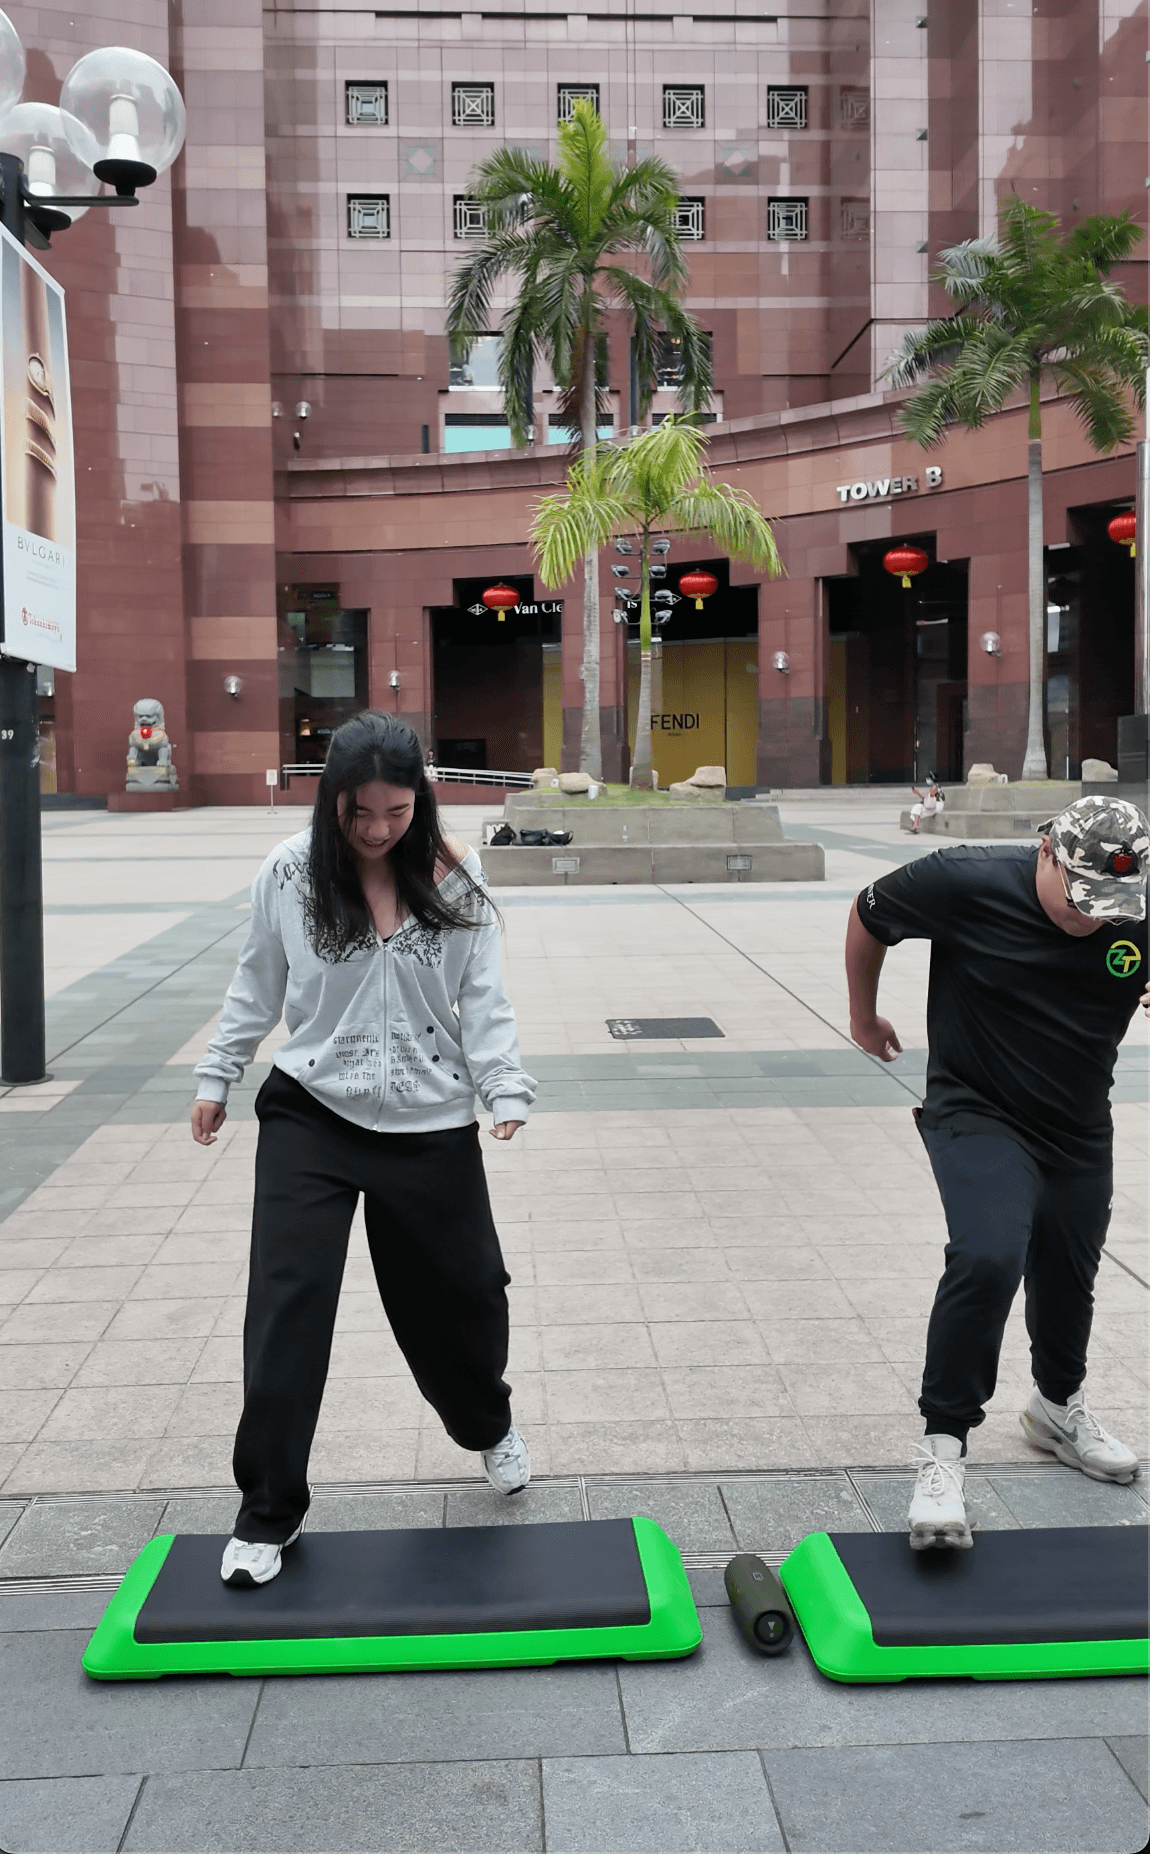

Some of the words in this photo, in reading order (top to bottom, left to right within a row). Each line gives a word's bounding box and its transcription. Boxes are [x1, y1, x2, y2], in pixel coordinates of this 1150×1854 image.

[836, 475, 918, 502] TOWER
[925, 466, 943, 488] B
[17, 535, 65, 568] BVLGARI
[514, 602, 539, 614] Van
[541, 602, 563, 613] Cle
[650, 713, 700, 730] FENDI
